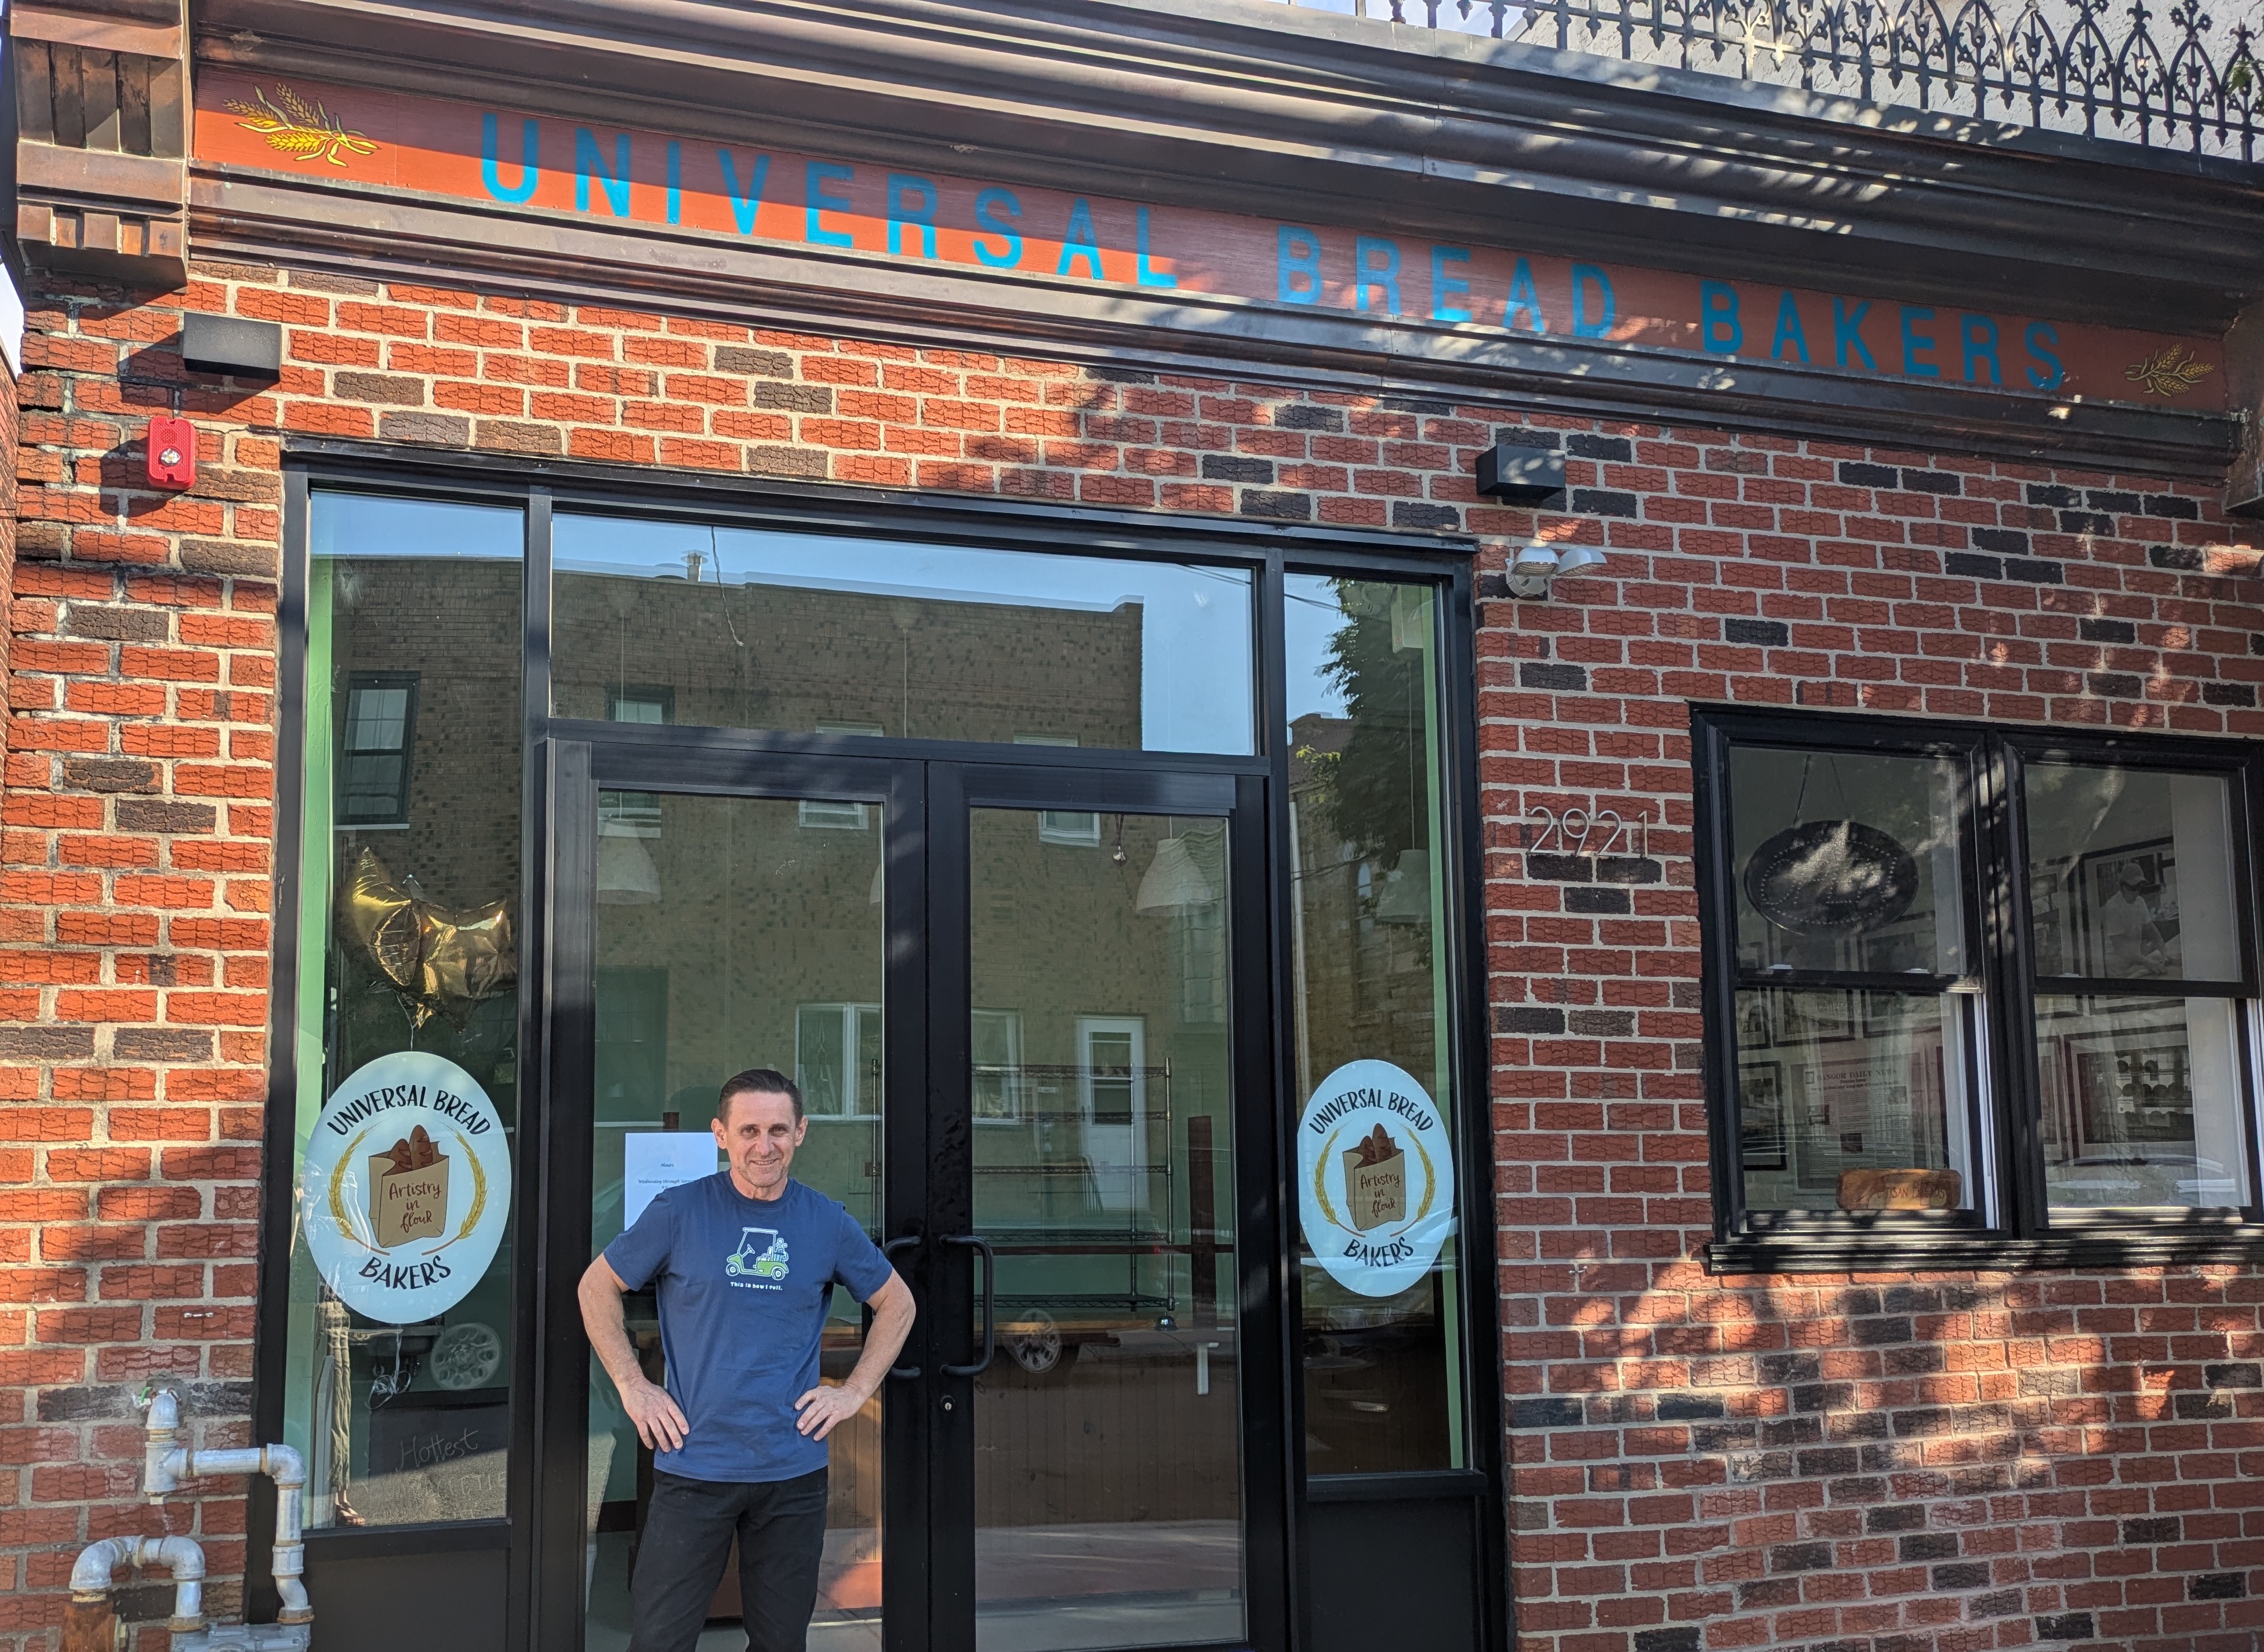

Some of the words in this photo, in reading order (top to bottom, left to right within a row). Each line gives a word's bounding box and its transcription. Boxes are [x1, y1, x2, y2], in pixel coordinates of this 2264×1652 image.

[482, 113, 1177, 289] UNIVERSAL
[1277, 225, 1615, 339] BREAD
[1700, 279, 2065, 391] BAKERS
[1529, 806, 1648, 858] 2921
[1817, 1072, 1847, 1081] BANGOR
[1849, 1070, 1872, 1078] DAILY
[327, 1085, 427, 1136] UNIVERSAL
[433, 1090, 490, 1135] BREAD
[1309, 1089, 1383, 1134] UNIVERSAL
[1387, 1091, 1433, 1131] BREAD
[388, 1181, 442, 1200] Artistry
[1360, 1173, 1402, 1189] Artistry
[1374, 1188, 1385, 1198] in
[406, 1198, 420, 1210] in
[1343, 1236, 1413, 1267] BAKERS
[358, 1256, 451, 1290] BAKERS
[395, 1428, 478, 1472] Hottest
